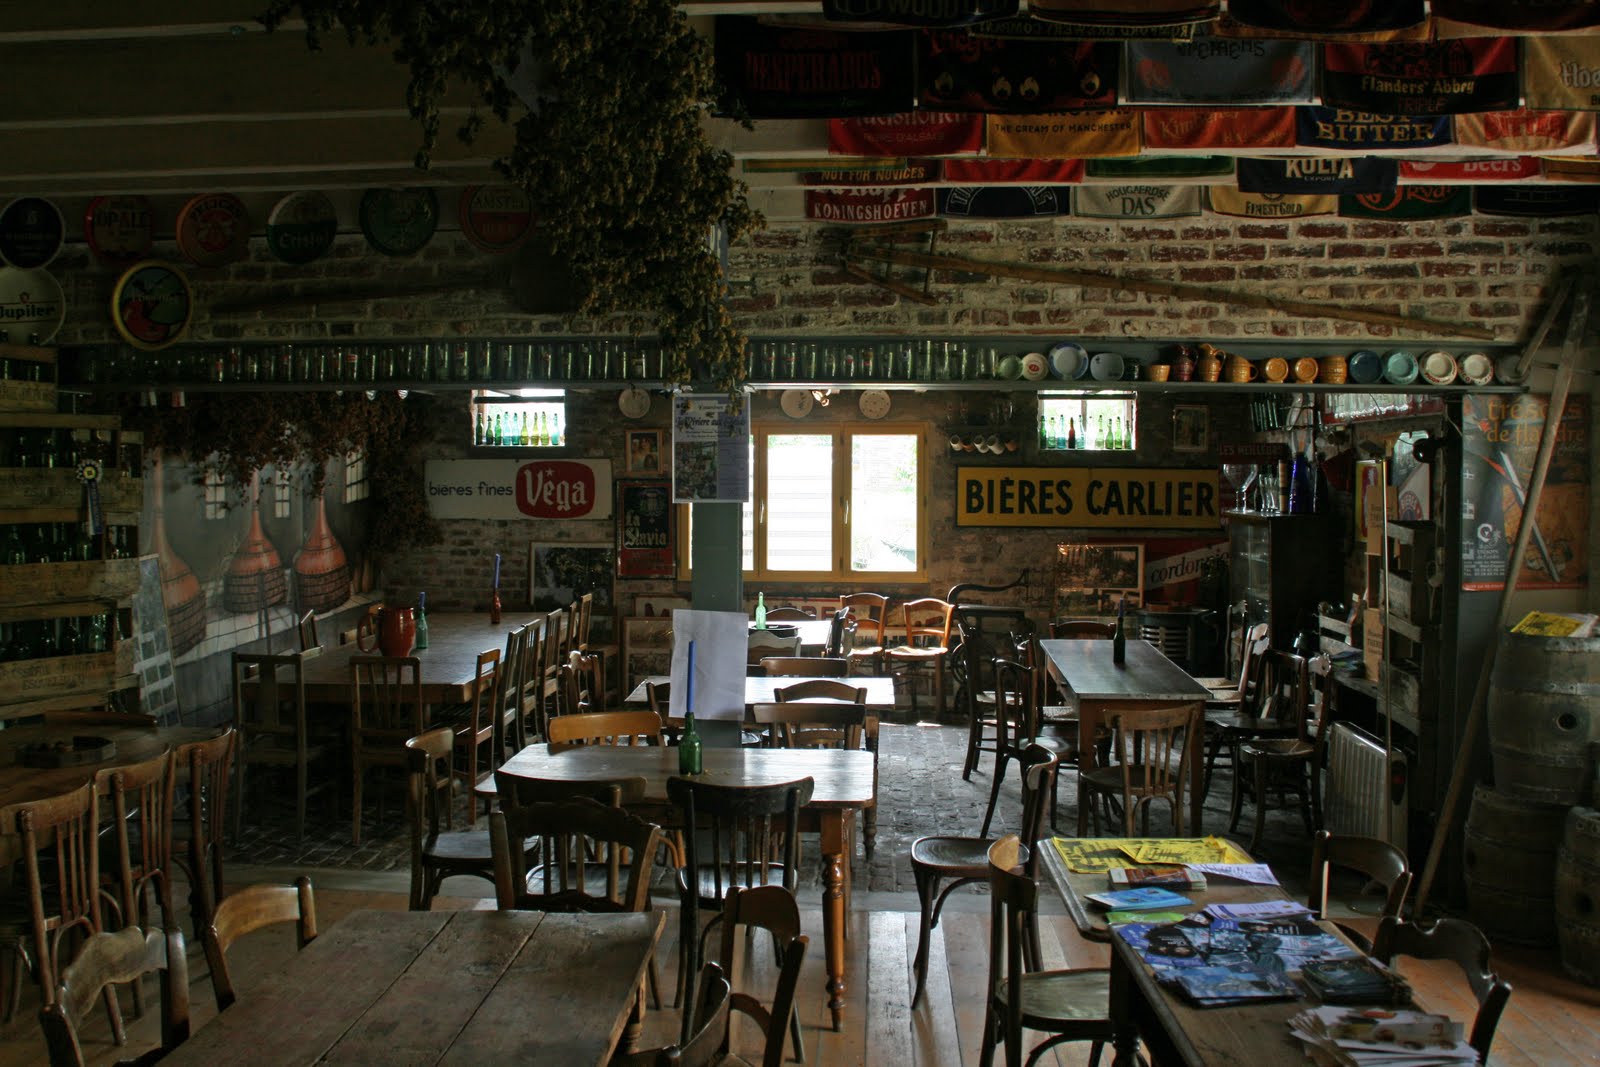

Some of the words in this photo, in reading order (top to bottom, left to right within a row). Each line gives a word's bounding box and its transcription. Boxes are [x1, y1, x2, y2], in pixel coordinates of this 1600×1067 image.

[1433, 77, 1476, 95] Abbey
[994, 123, 1011, 134] THE
[1015, 124, 1049, 134] CREAM
[1051, 124, 1065, 133] OF
[1068, 121, 1132, 133] MANCHESTER
[1316, 121, 1435, 143] BITTER
[821, 170, 844, 181] NOT
[848, 169, 871, 181] FOR
[875, 167, 926, 181] NOVICES
[814, 200, 928, 220] KONINGSHOEVEN
[1121, 197, 1156, 215] DAS
[1245, 200, 1280, 215] FINEST
[1280, 201, 1303, 215] GOLD
[1487, 421, 1511, 443] de
[1515, 422, 1585, 447] fladre
[478, 481, 514, 496] fines
[1086, 479, 1216, 517] CARLIER
